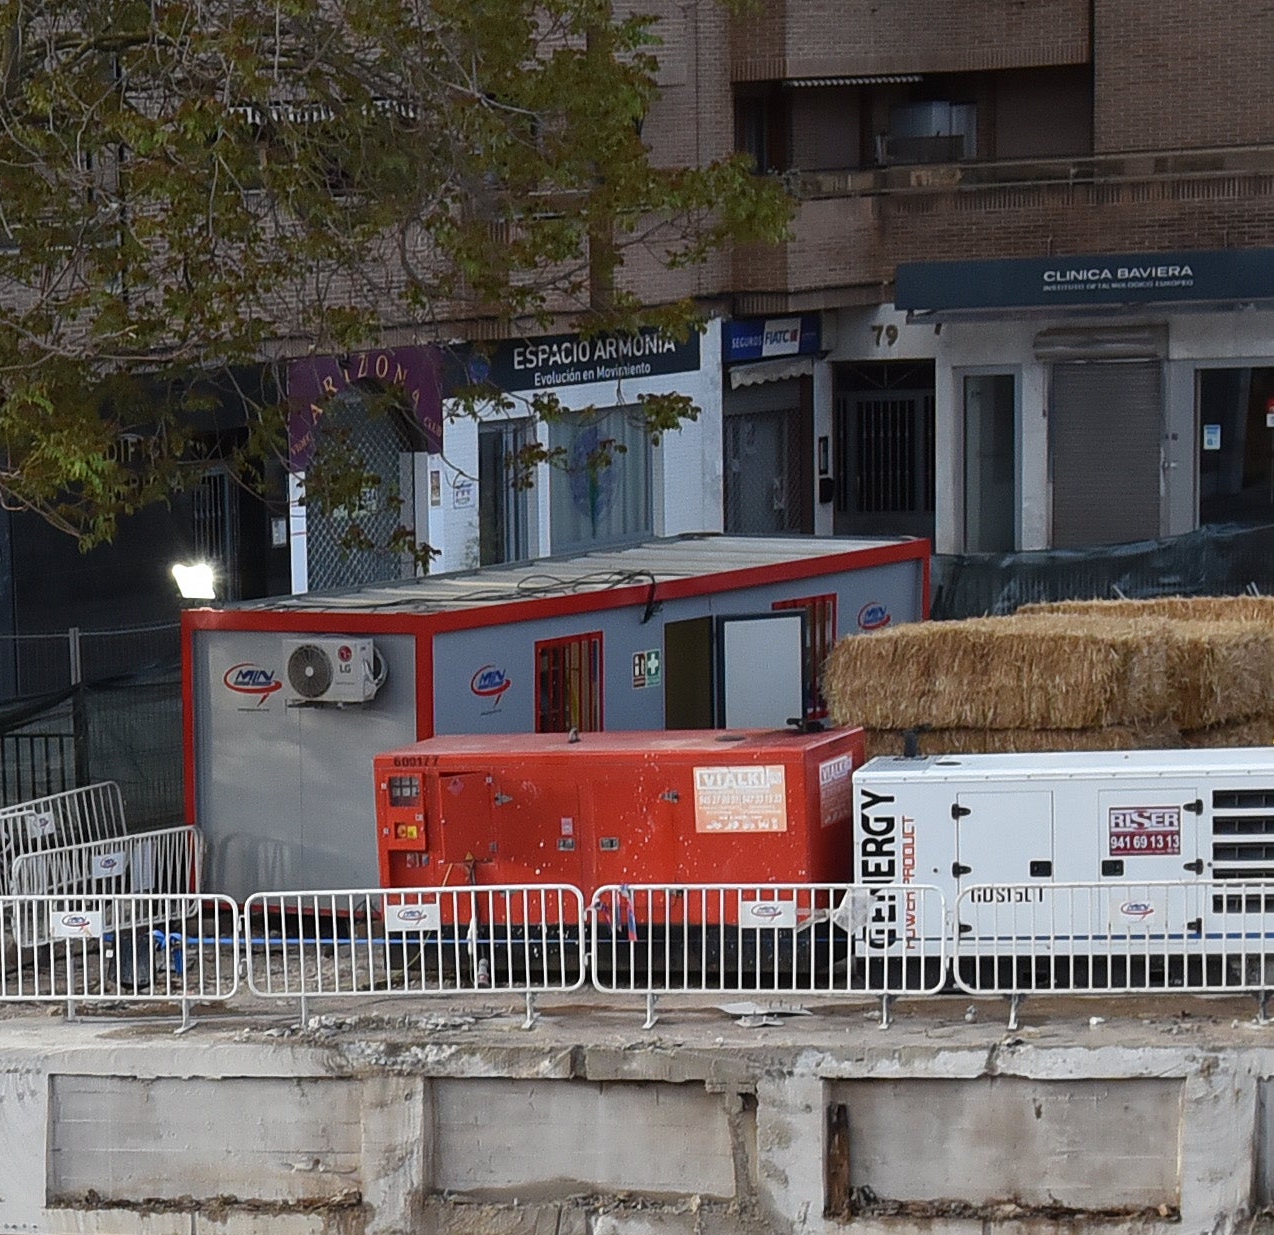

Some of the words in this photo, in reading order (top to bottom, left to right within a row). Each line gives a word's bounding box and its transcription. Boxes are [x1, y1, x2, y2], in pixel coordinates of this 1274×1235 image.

[1043, 268, 1113, 282] CLINICA
[1117, 265, 1193, 279] BAVIERA
[731, 334, 762, 350] SEGUROS
[765, 329, 789, 345] FIATC
[871, 324, 899, 348] 79
[513, 341, 590, 370] ESPACIO
[534, 367, 581, 387] Evolución
[583, 371, 595, 381] en
[597, 361, 651, 379] Movimiento
[339, 664, 352, 674] LG
[1111, 811, 1178, 829] RISER
[1110, 835, 1131, 850] 941
[1133, 835, 1148, 850] 69
[1150, 834, 1164, 849] 13
[1166, 834, 1180, 848] 13
